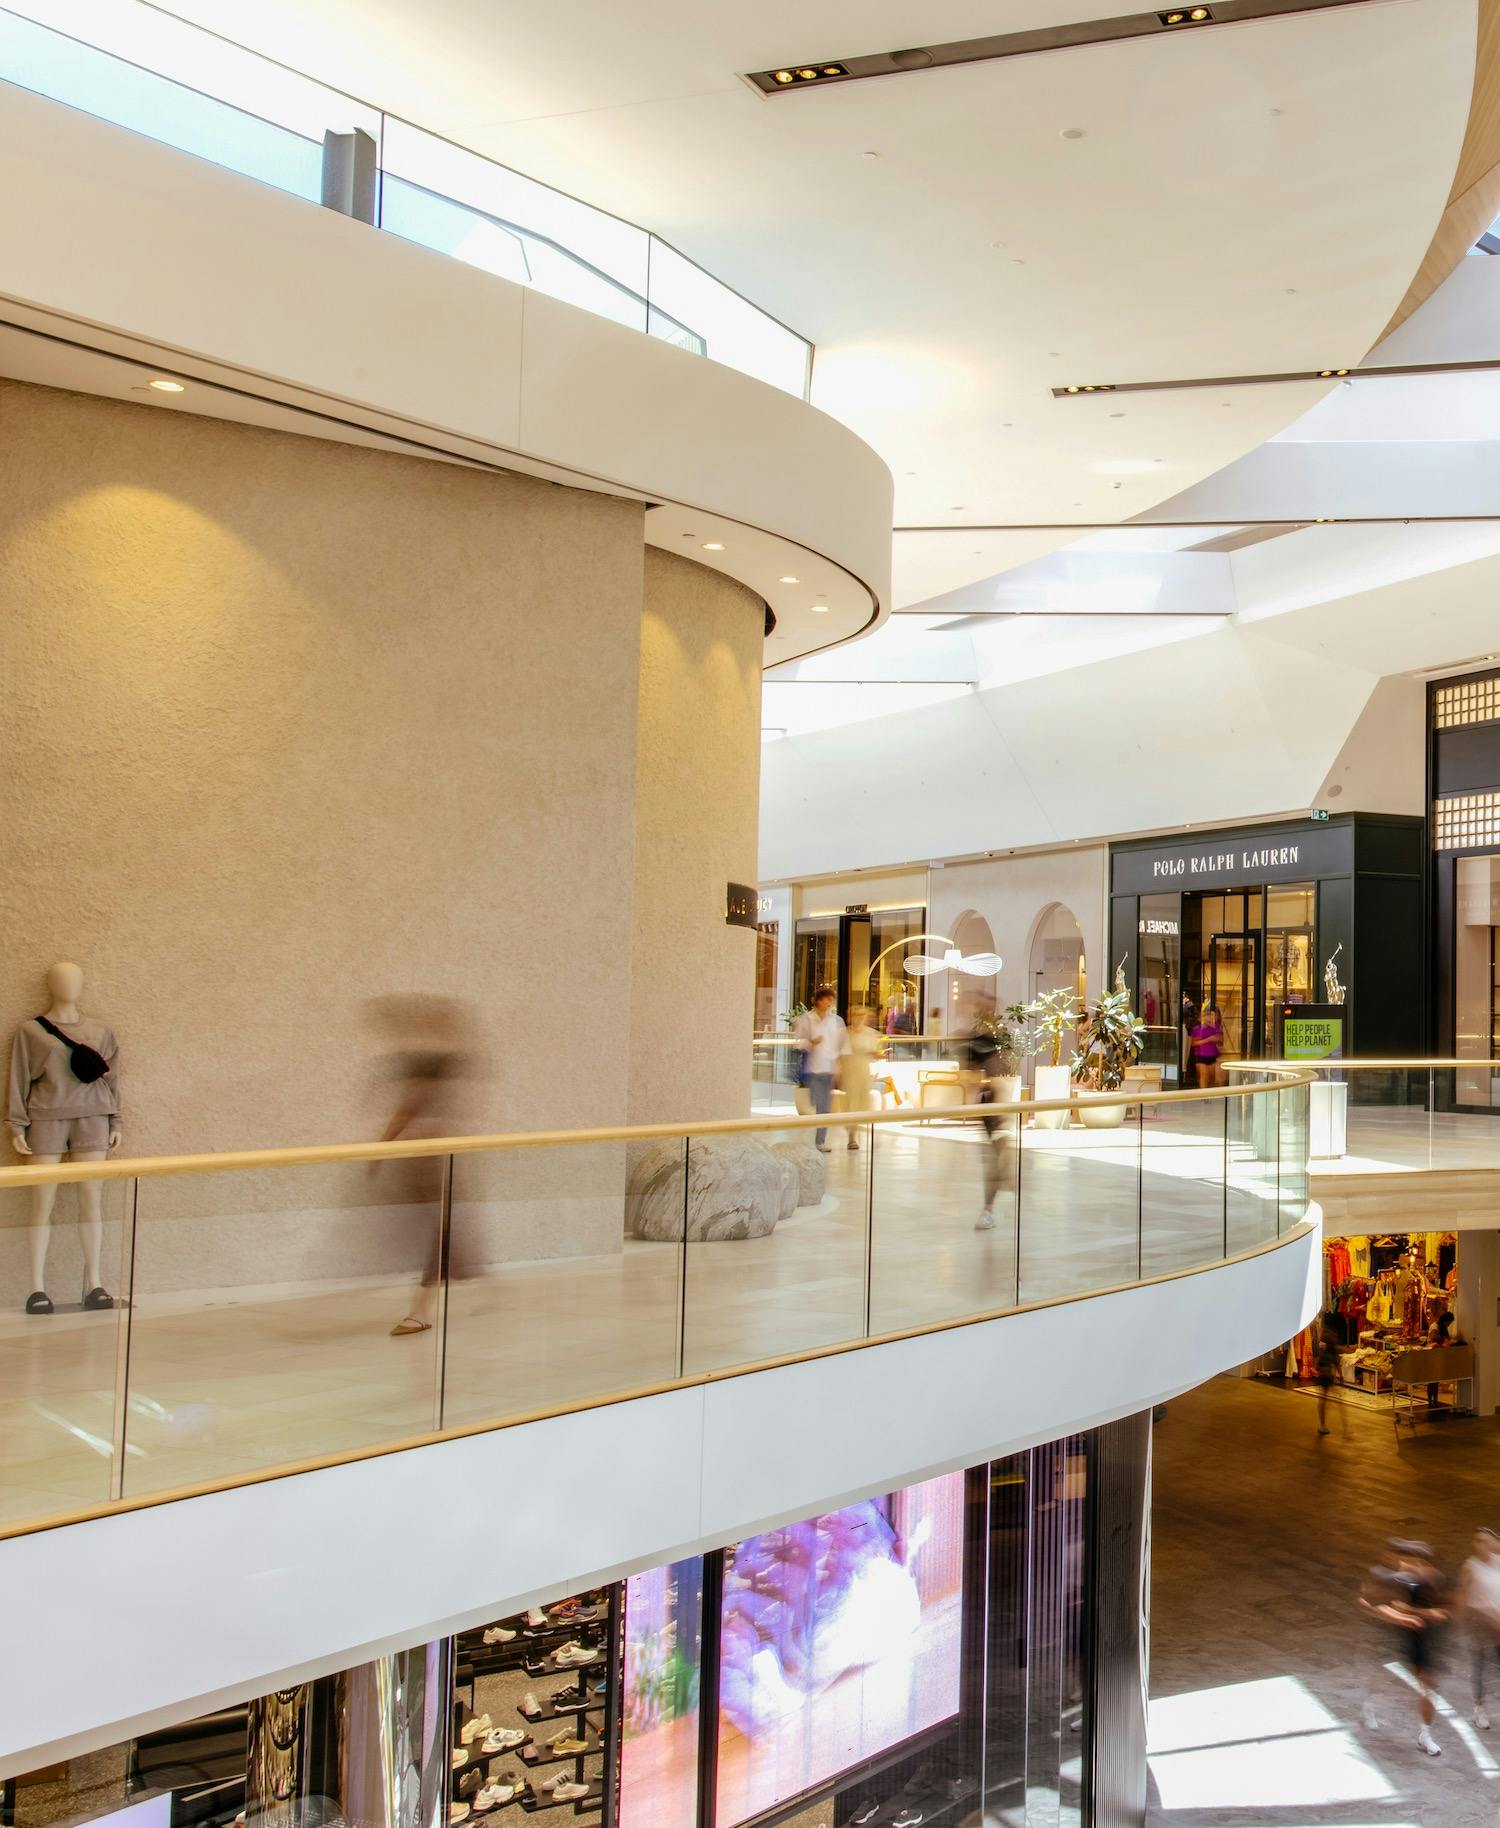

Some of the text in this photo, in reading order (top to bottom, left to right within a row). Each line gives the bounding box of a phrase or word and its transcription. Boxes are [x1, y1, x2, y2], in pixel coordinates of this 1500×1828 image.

[1153, 846, 1299, 877] POLO RALPH LAUREN
[1286, 1024, 1331, 1035] HELP PEOPLE
[1286, 1036, 1331, 1047] HELP PLANET
